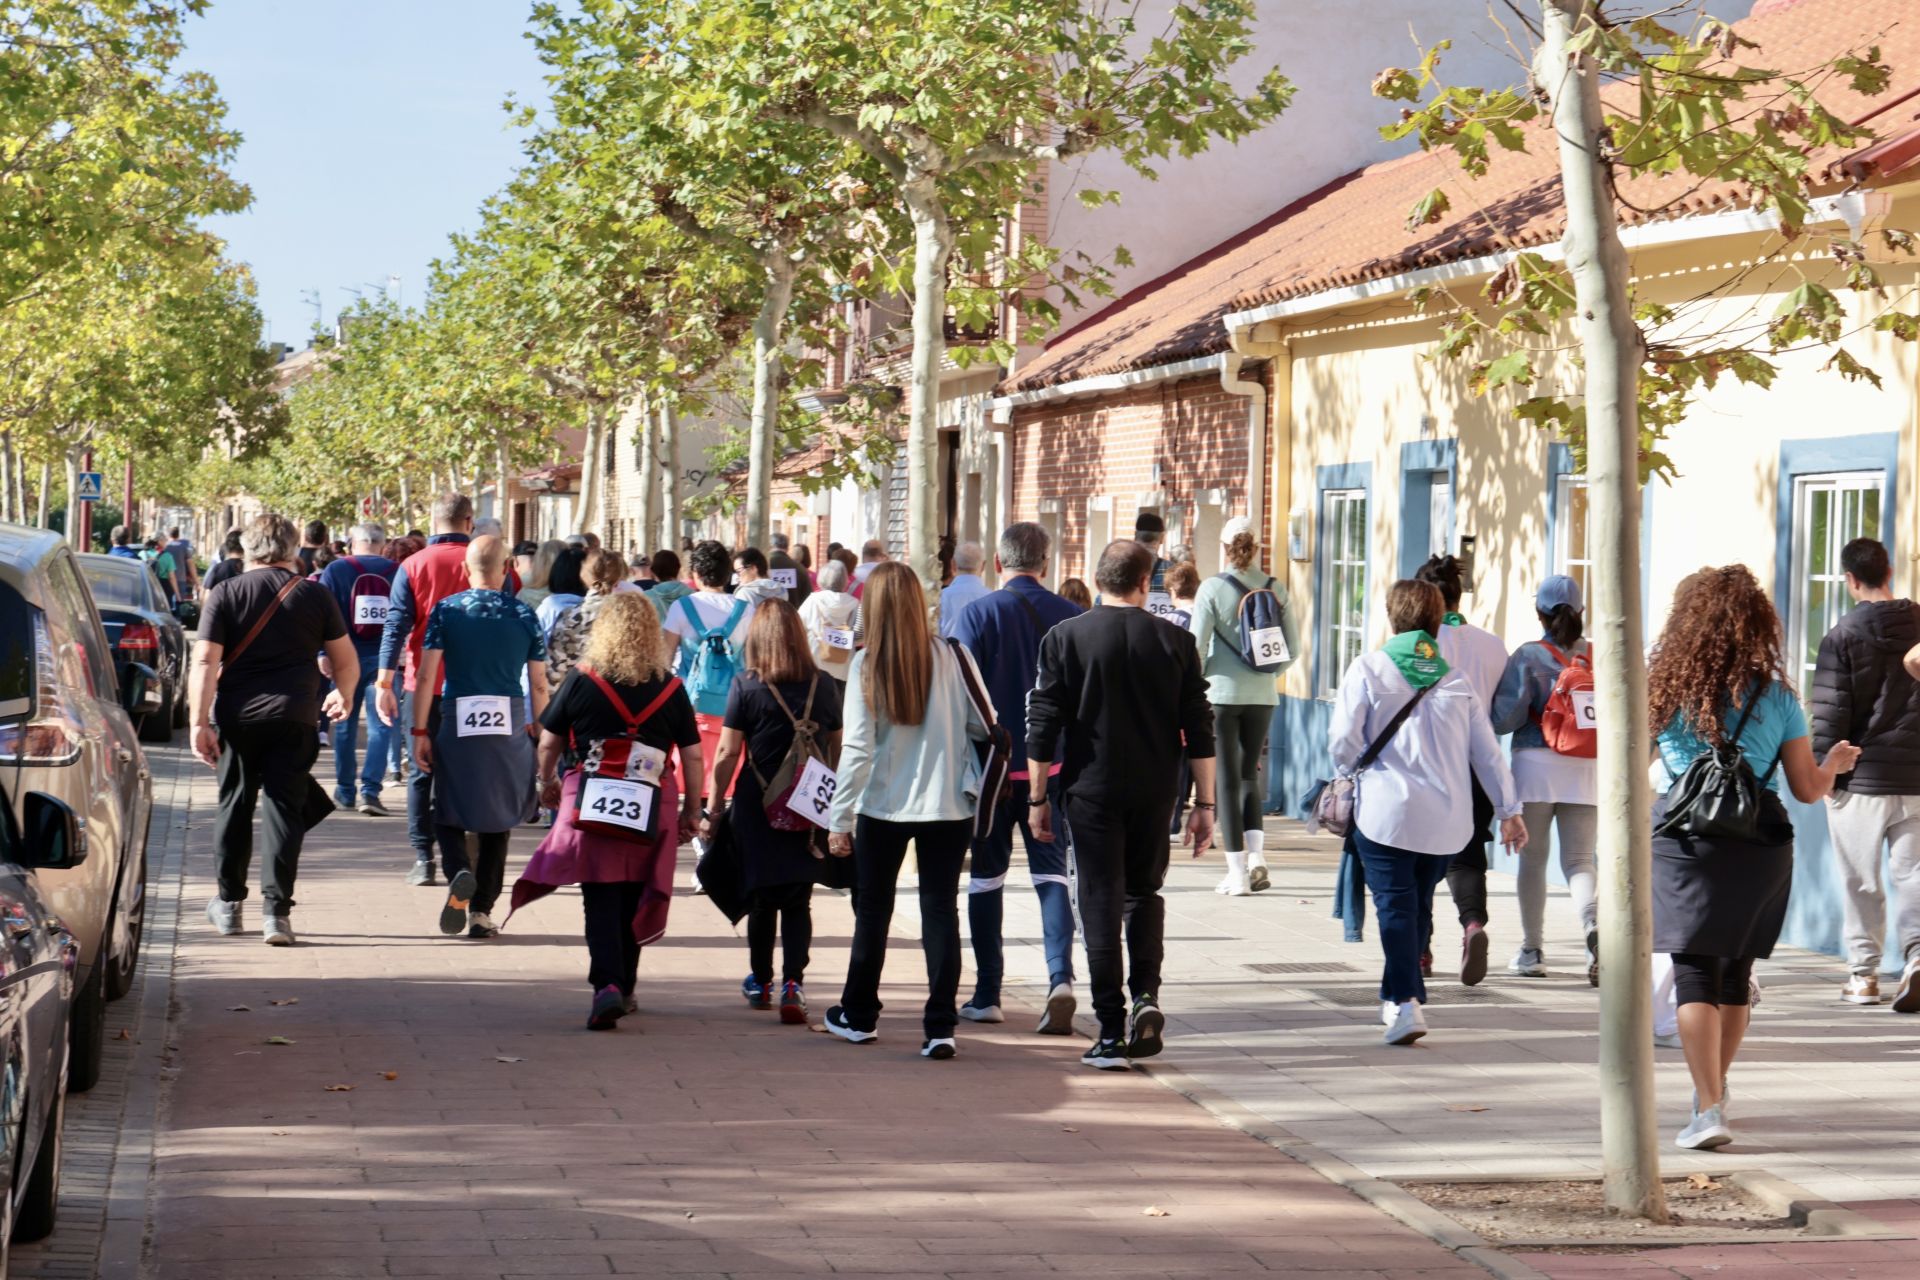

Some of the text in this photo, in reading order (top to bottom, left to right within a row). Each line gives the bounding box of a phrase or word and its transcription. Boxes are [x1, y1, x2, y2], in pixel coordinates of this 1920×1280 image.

[361, 607, 388, 619] 368
[827, 634, 849, 646] 123
[1261, 641, 1284, 658] 39
[465, 711, 505, 728] 422
[811, 774, 837, 815] 425
[592, 797, 641, 821] 423
